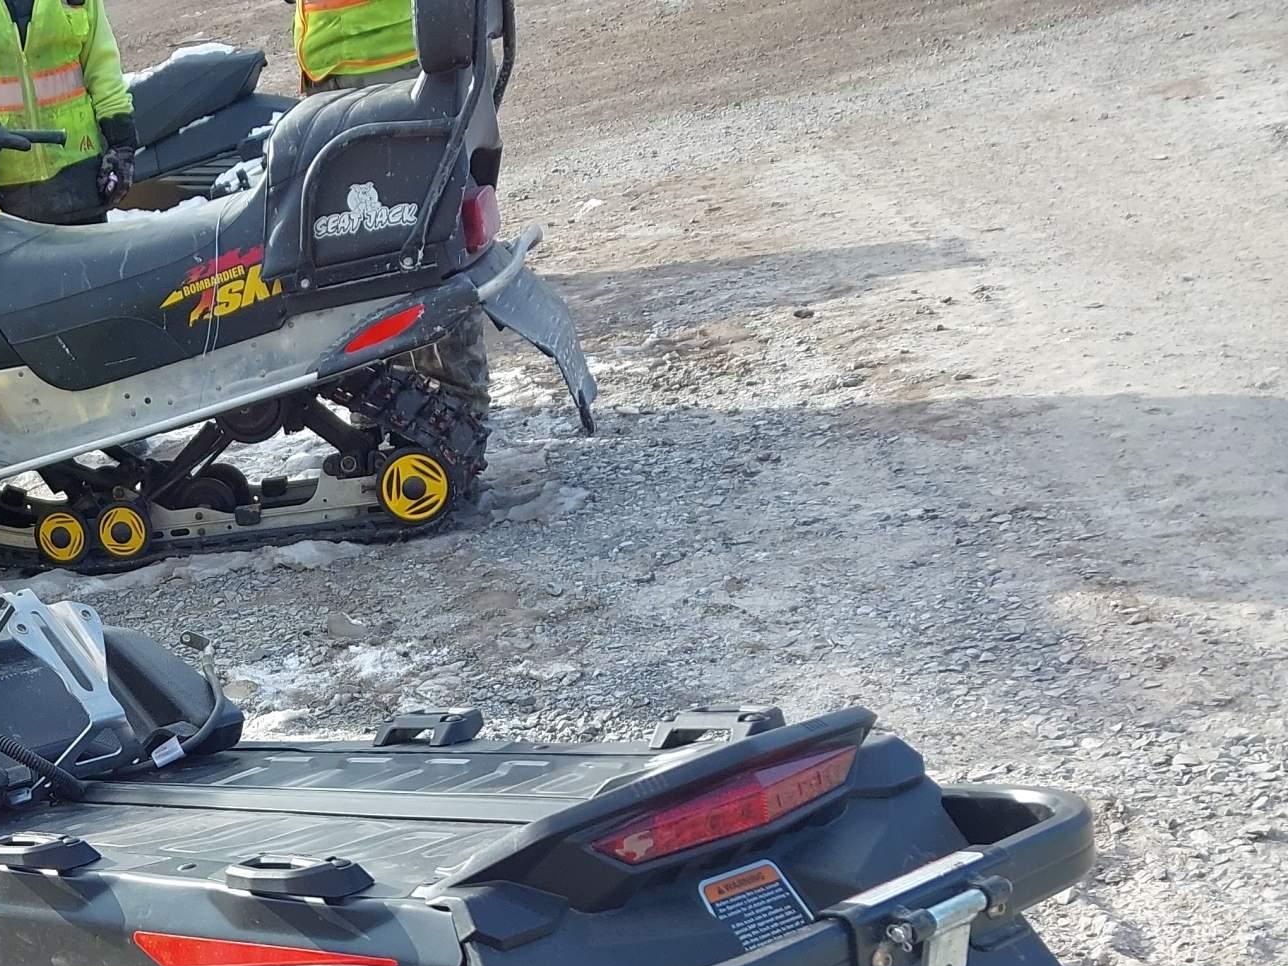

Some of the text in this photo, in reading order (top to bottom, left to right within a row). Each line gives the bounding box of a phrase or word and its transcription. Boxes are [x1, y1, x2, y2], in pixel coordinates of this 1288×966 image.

[313, 203, 418, 238] SEAT JACK
[182, 264, 246, 297] BOMBARDIER
